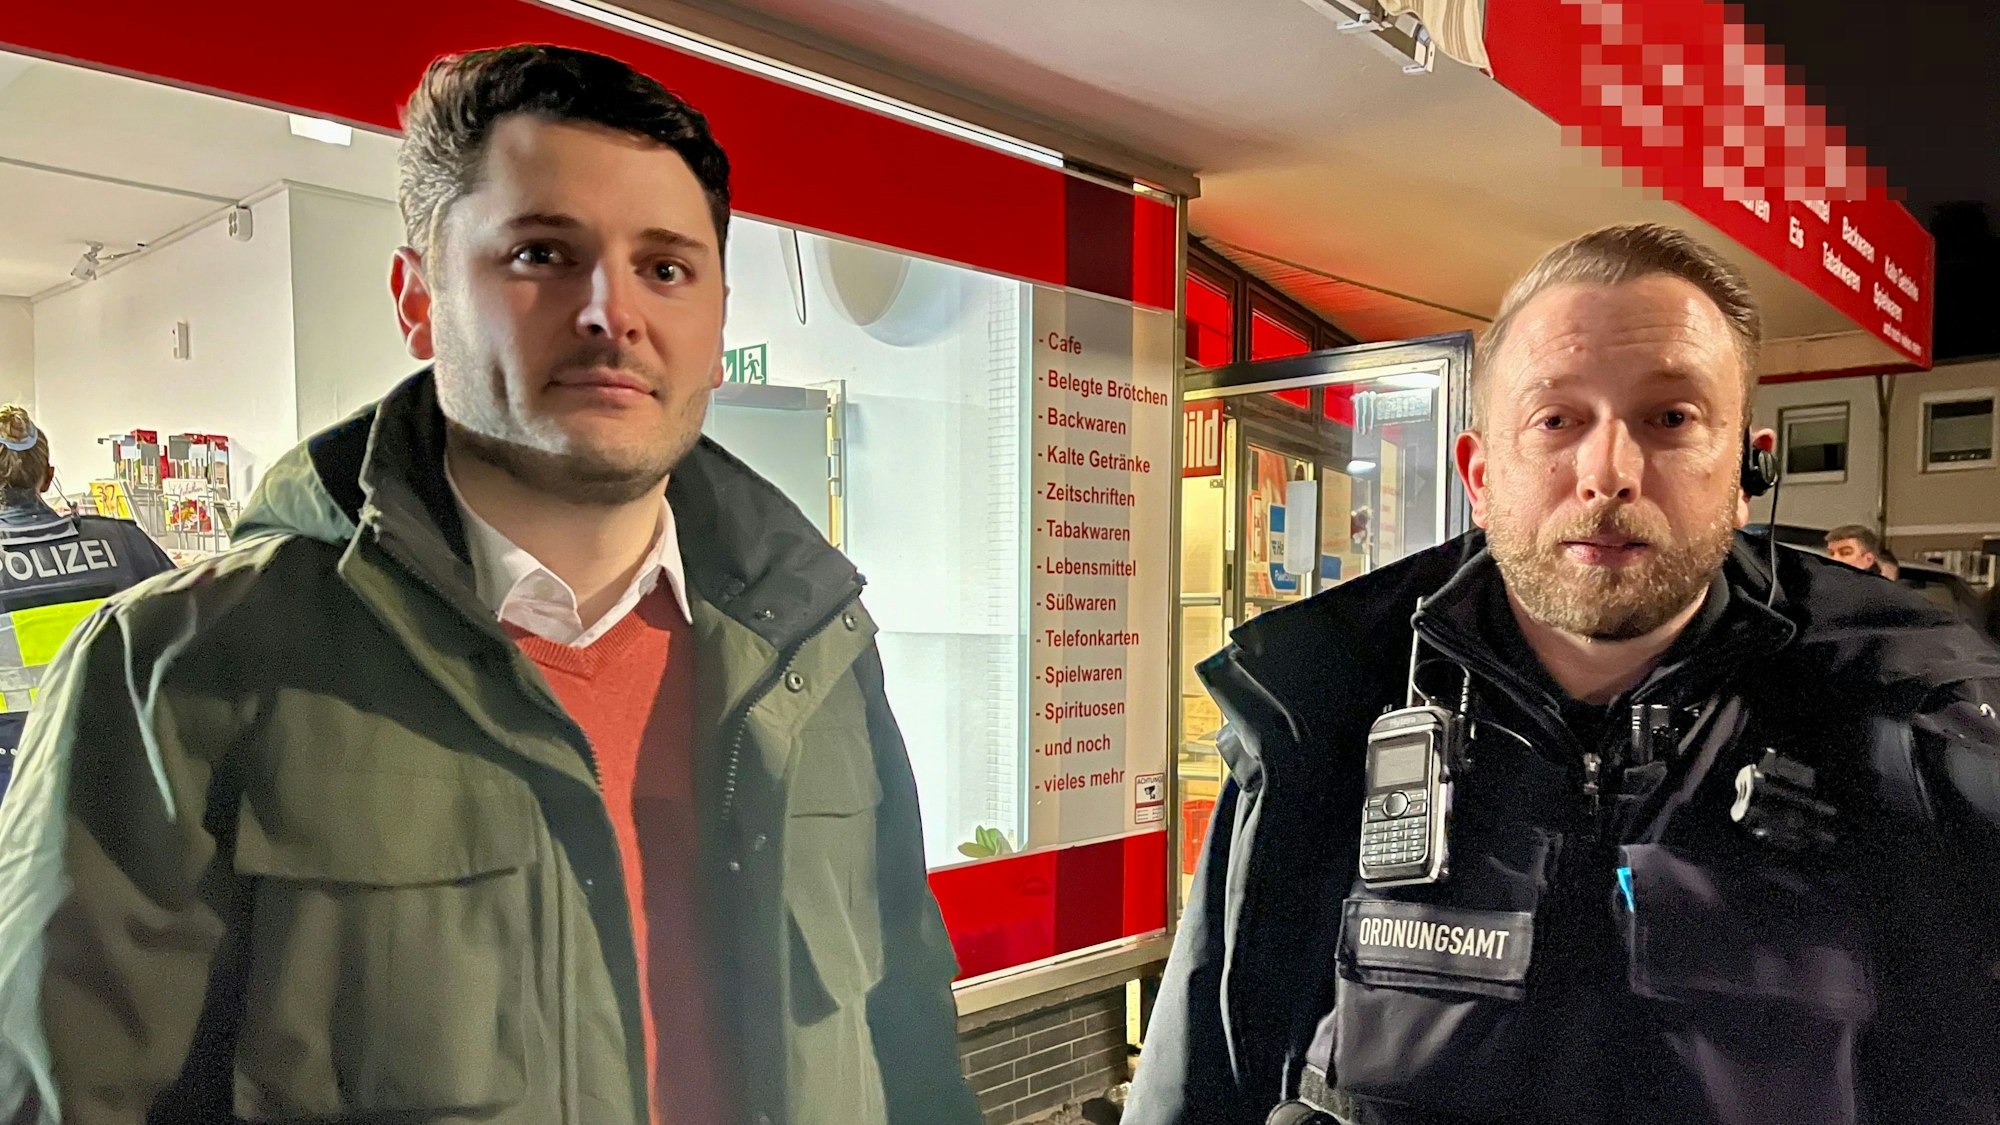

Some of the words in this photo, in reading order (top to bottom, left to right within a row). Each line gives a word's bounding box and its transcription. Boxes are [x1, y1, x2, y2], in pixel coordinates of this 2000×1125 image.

[1048, 332, 1082, 355] Cafe
[1048, 369, 1103, 397] Belegte
[1107, 380, 1168, 406] Brötchen
[1048, 407, 1126, 435] Backwaren
[1047, 445, 1085, 465] Kalte
[1089, 450, 1151, 474] Getränke
[1046, 482, 1136, 507] Zeitschriften
[1046, 519, 1130, 542] Tabakwaren
[0, 538, 118, 582] OLIZEI
[1046, 557, 1137, 577] Lebensmittel
[1046, 592, 1117, 612] Süßwaren
[1045, 629, 1139, 648] Telefonkarten
[1045, 665, 1122, 688] Spielwaren
[1045, 701, 1125, 724] Spirituosen
[1045, 737, 1072, 757] und
[1076, 734, 1111, 753] noch
[1044, 775, 1086, 793] vieles
[1090, 768, 1125, 788] mehr
[1359, 917, 1510, 960] ORDNUNGSAMT
